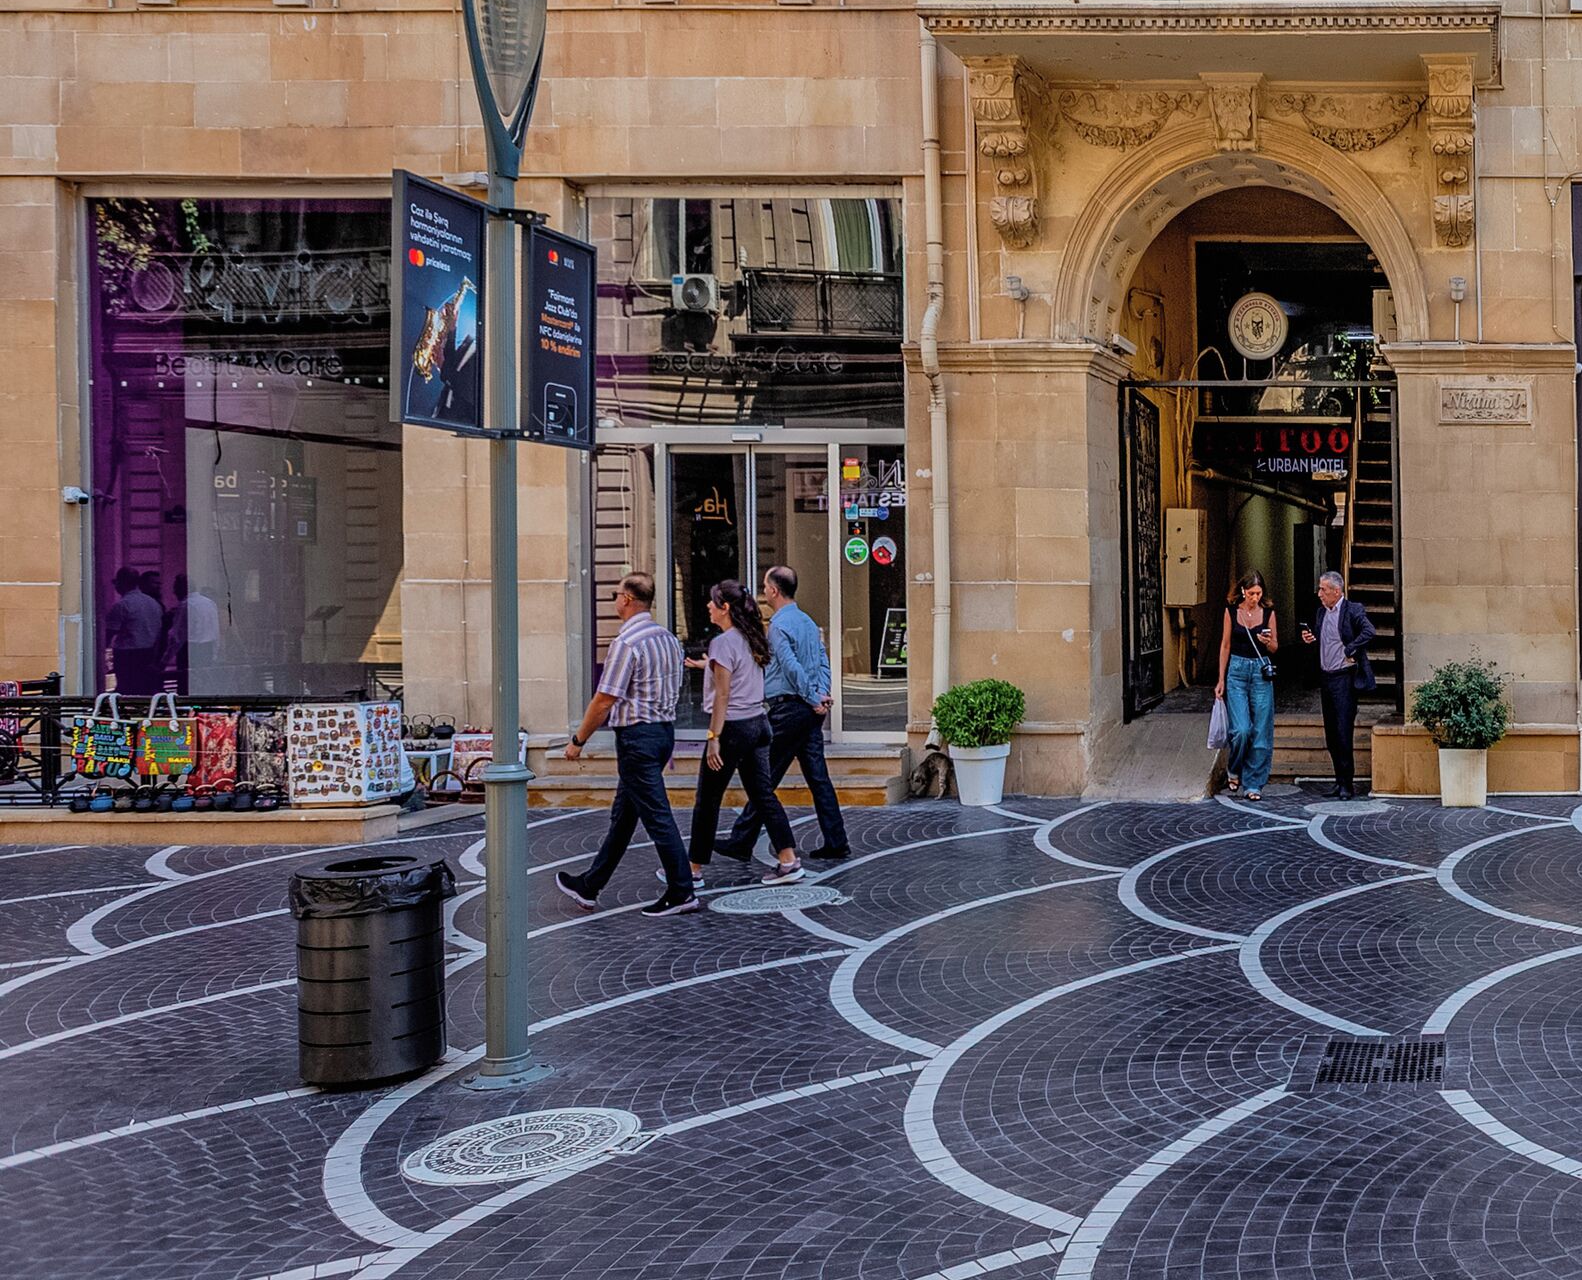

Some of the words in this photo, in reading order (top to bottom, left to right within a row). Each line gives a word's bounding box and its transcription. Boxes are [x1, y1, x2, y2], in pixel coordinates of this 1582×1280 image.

[411, 203, 425, 217] Caz
[426, 257, 452, 272] priceless
[539, 325, 552, 337] NFC
[155, 351, 245, 380] Beauty
[275, 350, 343, 376] Care
[775, 345, 843, 374] Care
[1268, 457, 1309, 473] URBAN
[1310, 457, 1345, 473] HOTEL
[77, 759, 120, 777] BAKU
